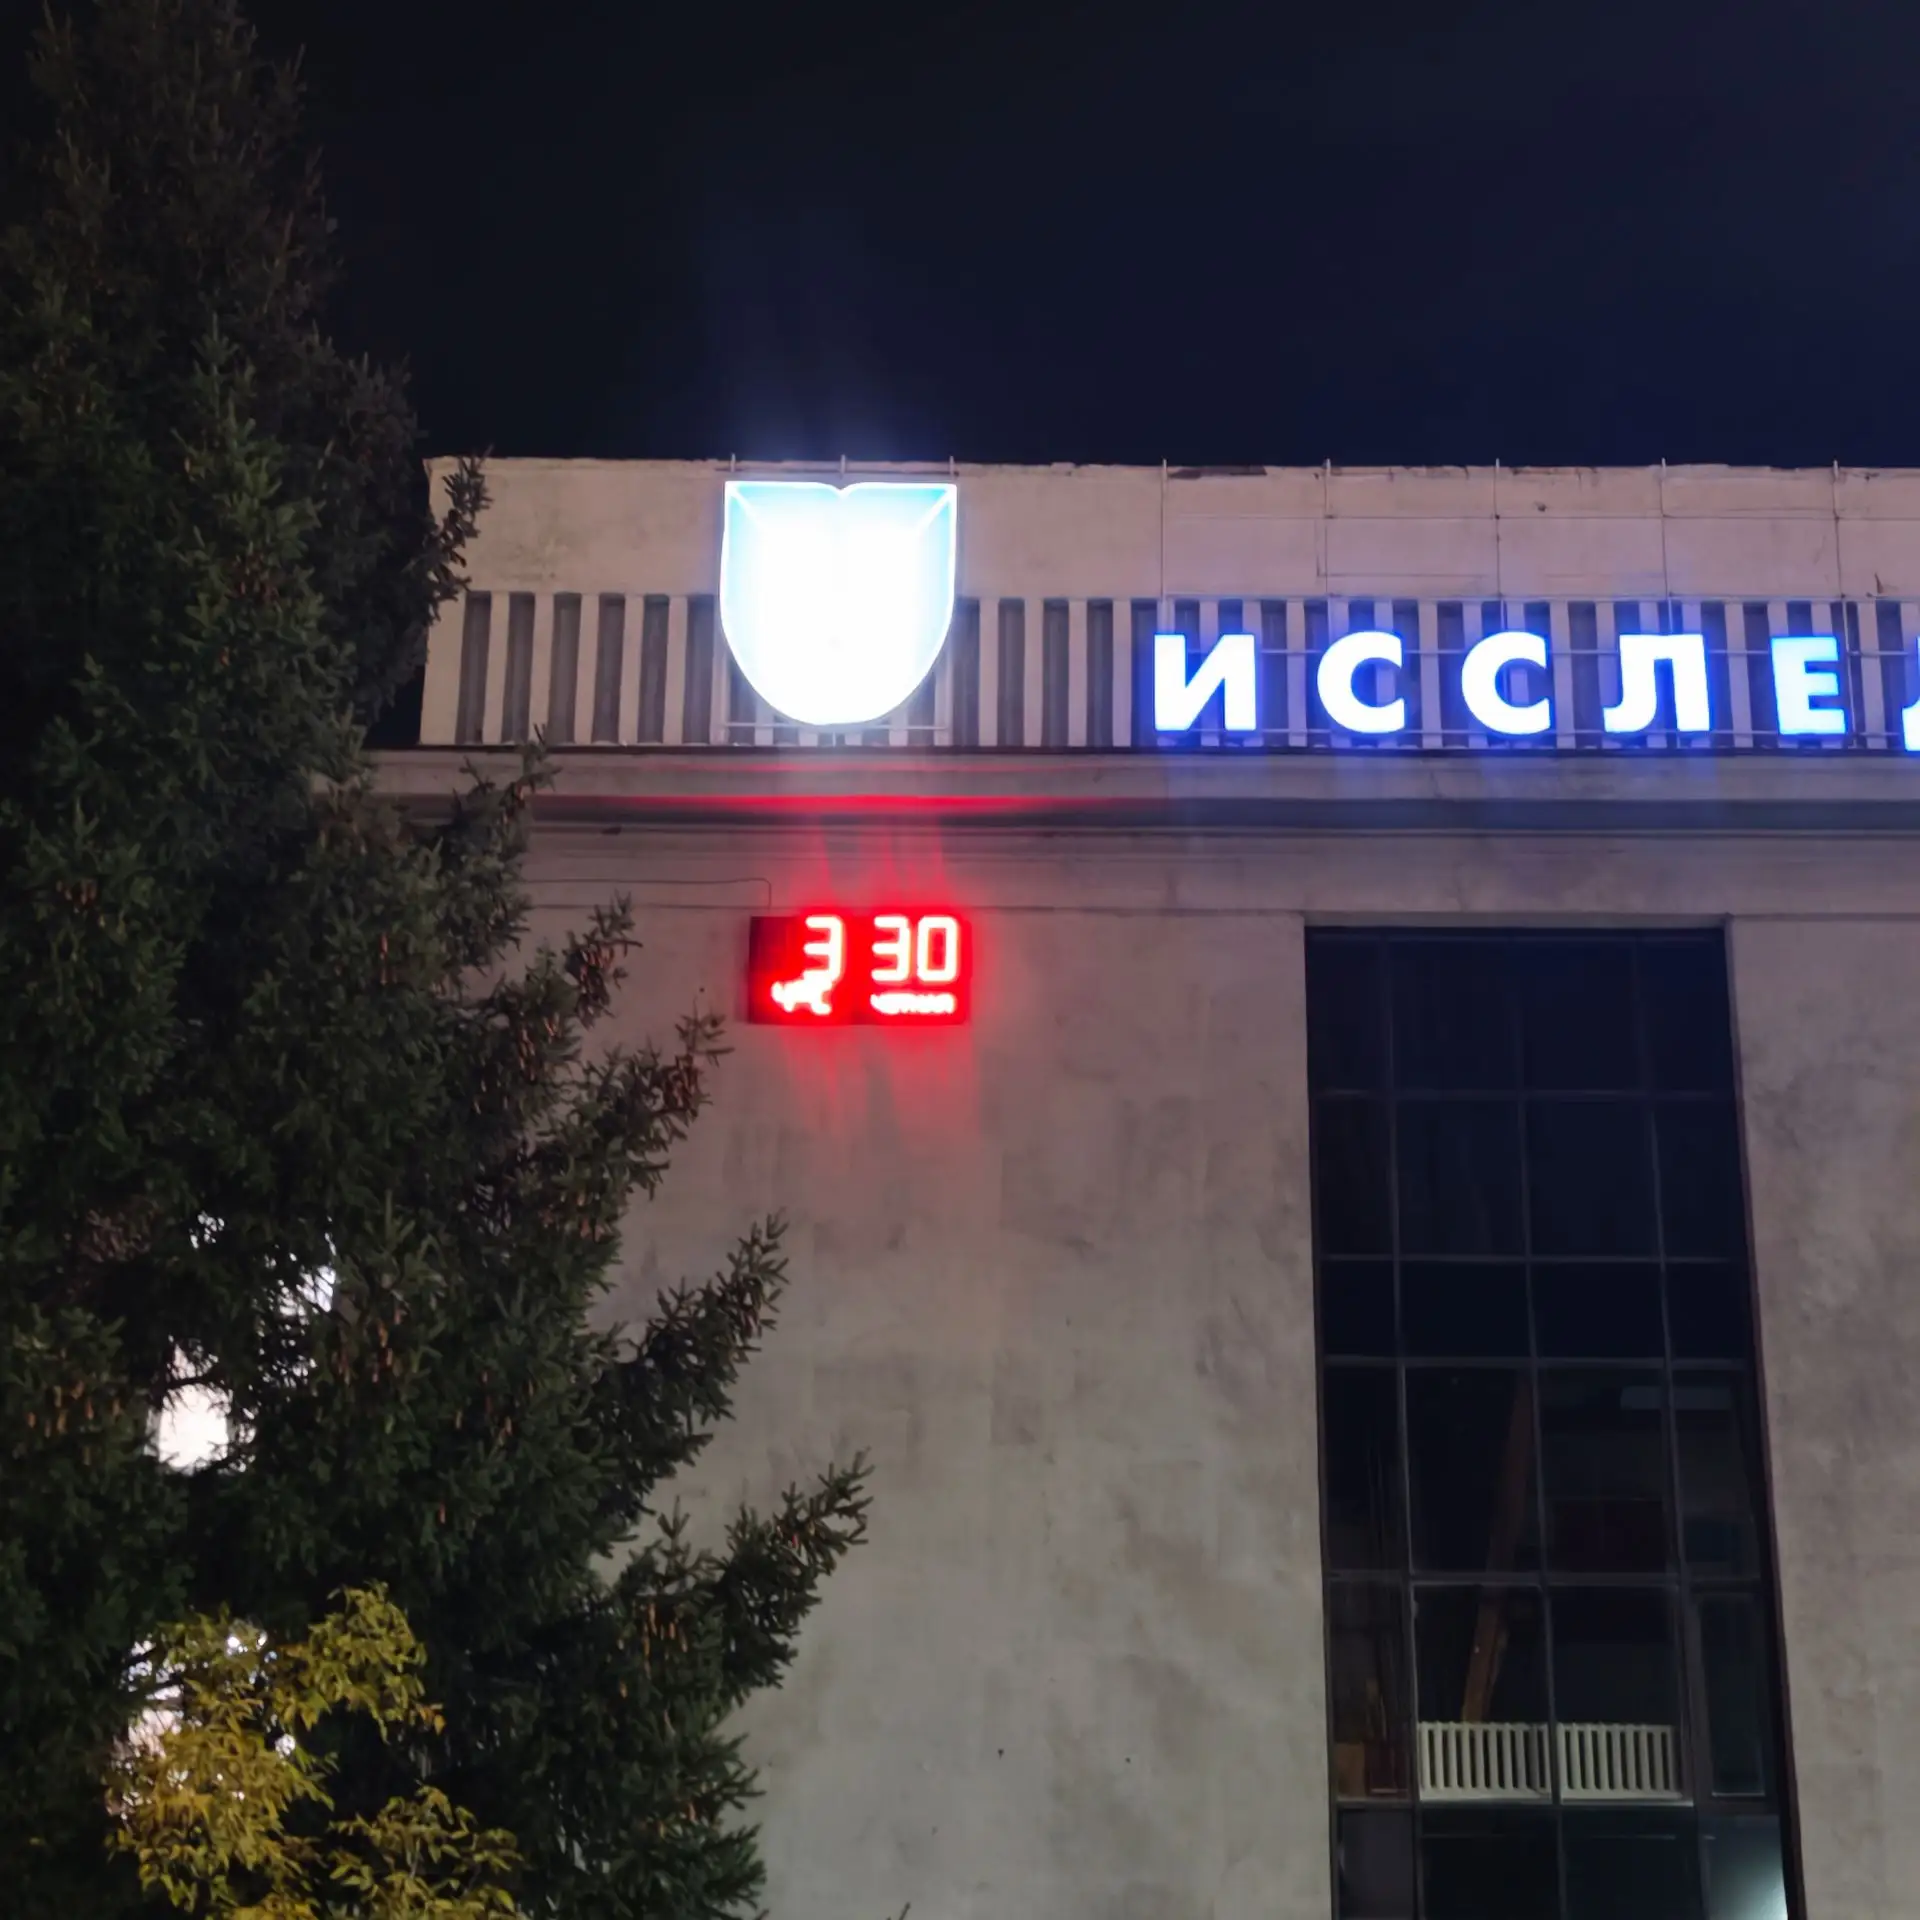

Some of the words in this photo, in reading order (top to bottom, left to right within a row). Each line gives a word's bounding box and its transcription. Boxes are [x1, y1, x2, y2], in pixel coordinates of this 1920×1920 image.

[1153, 631, 1920, 752] ИССЛЕ
[803, 914, 845, 983] 3
[870, 914, 961, 985] 30
